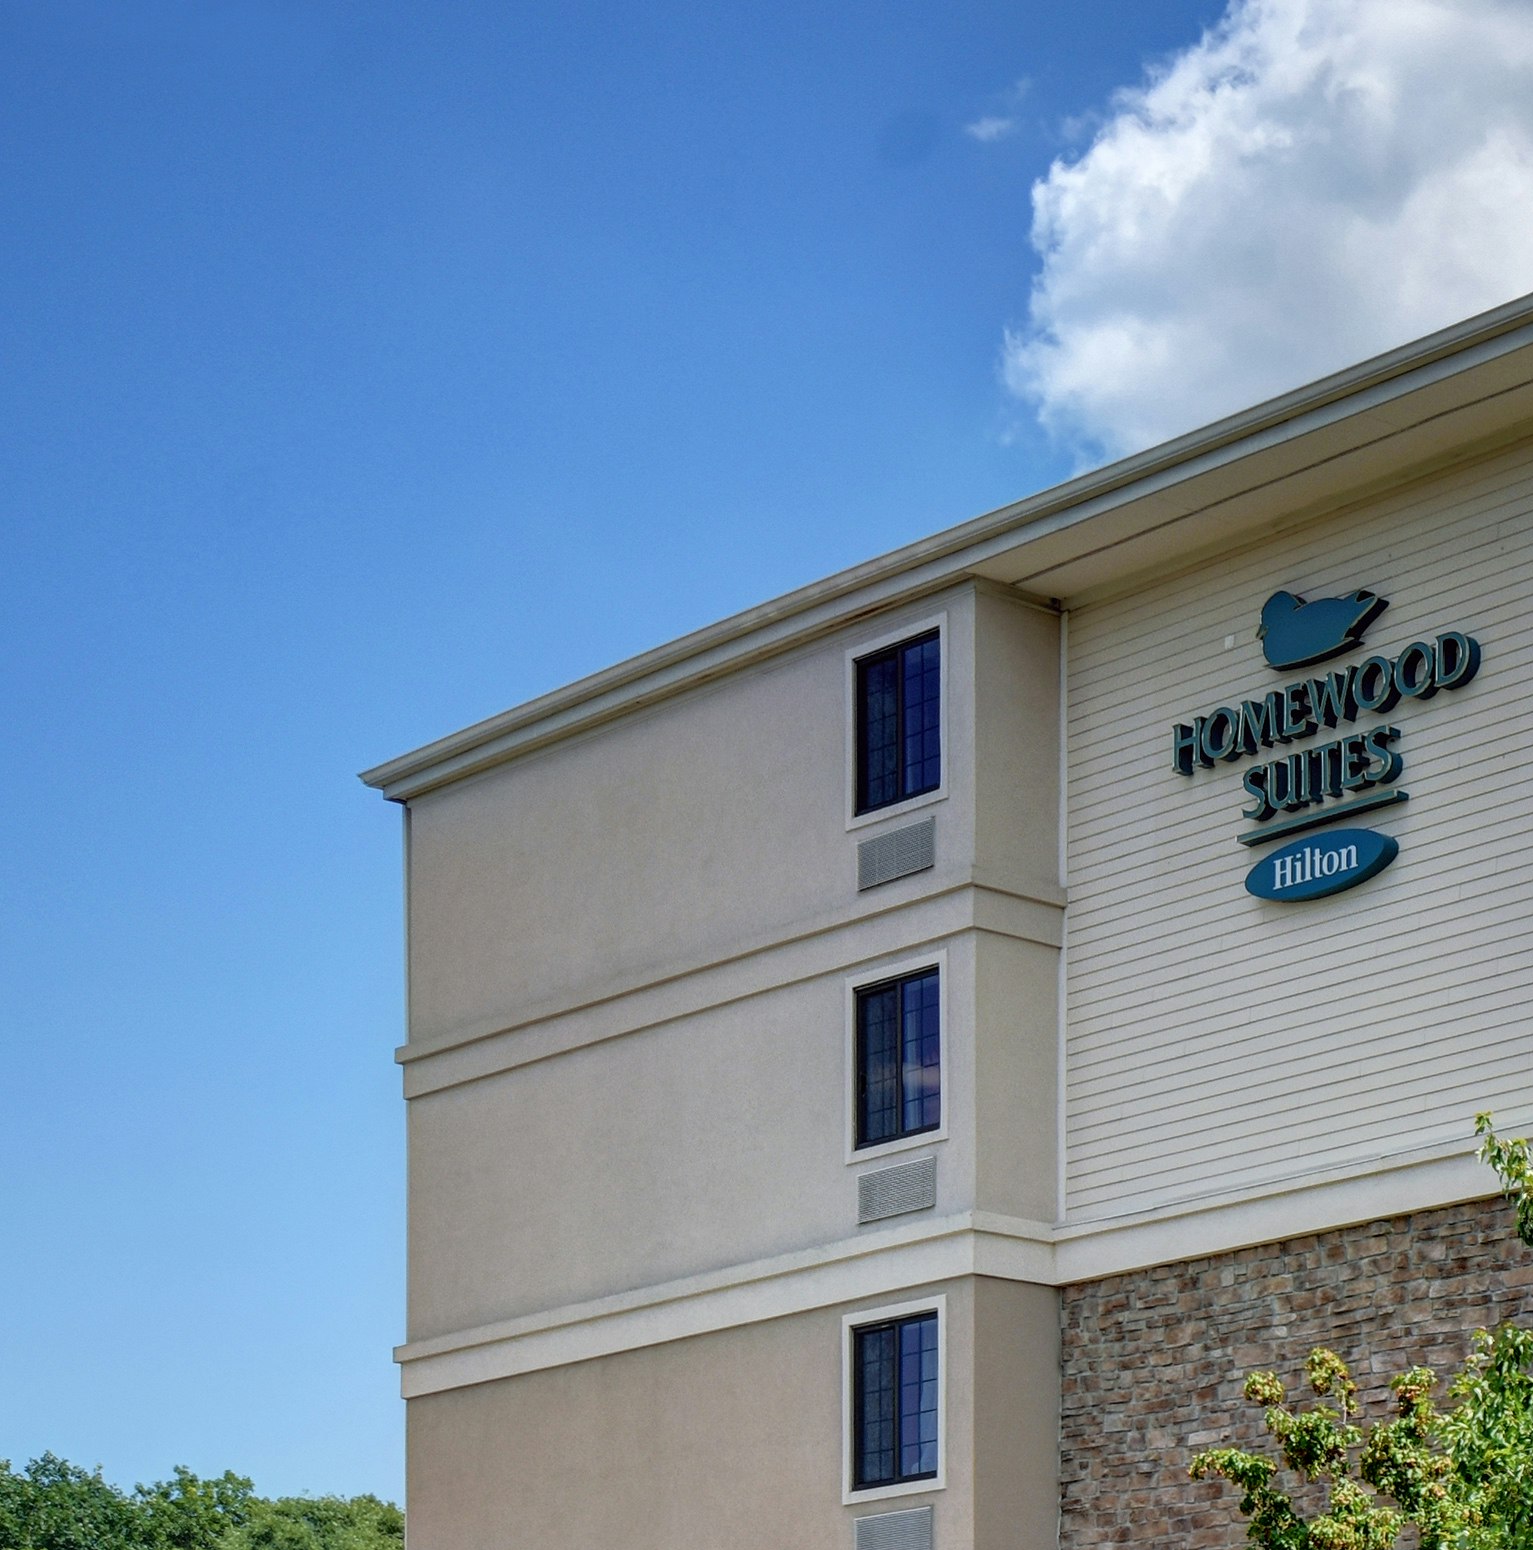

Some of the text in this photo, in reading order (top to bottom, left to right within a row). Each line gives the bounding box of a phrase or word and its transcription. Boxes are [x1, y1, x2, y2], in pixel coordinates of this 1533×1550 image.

[1172, 631, 1481, 775] HOMEWOOD
[1242, 725, 1403, 821] SUITES
[1273, 845, 1358, 890] Hilton
